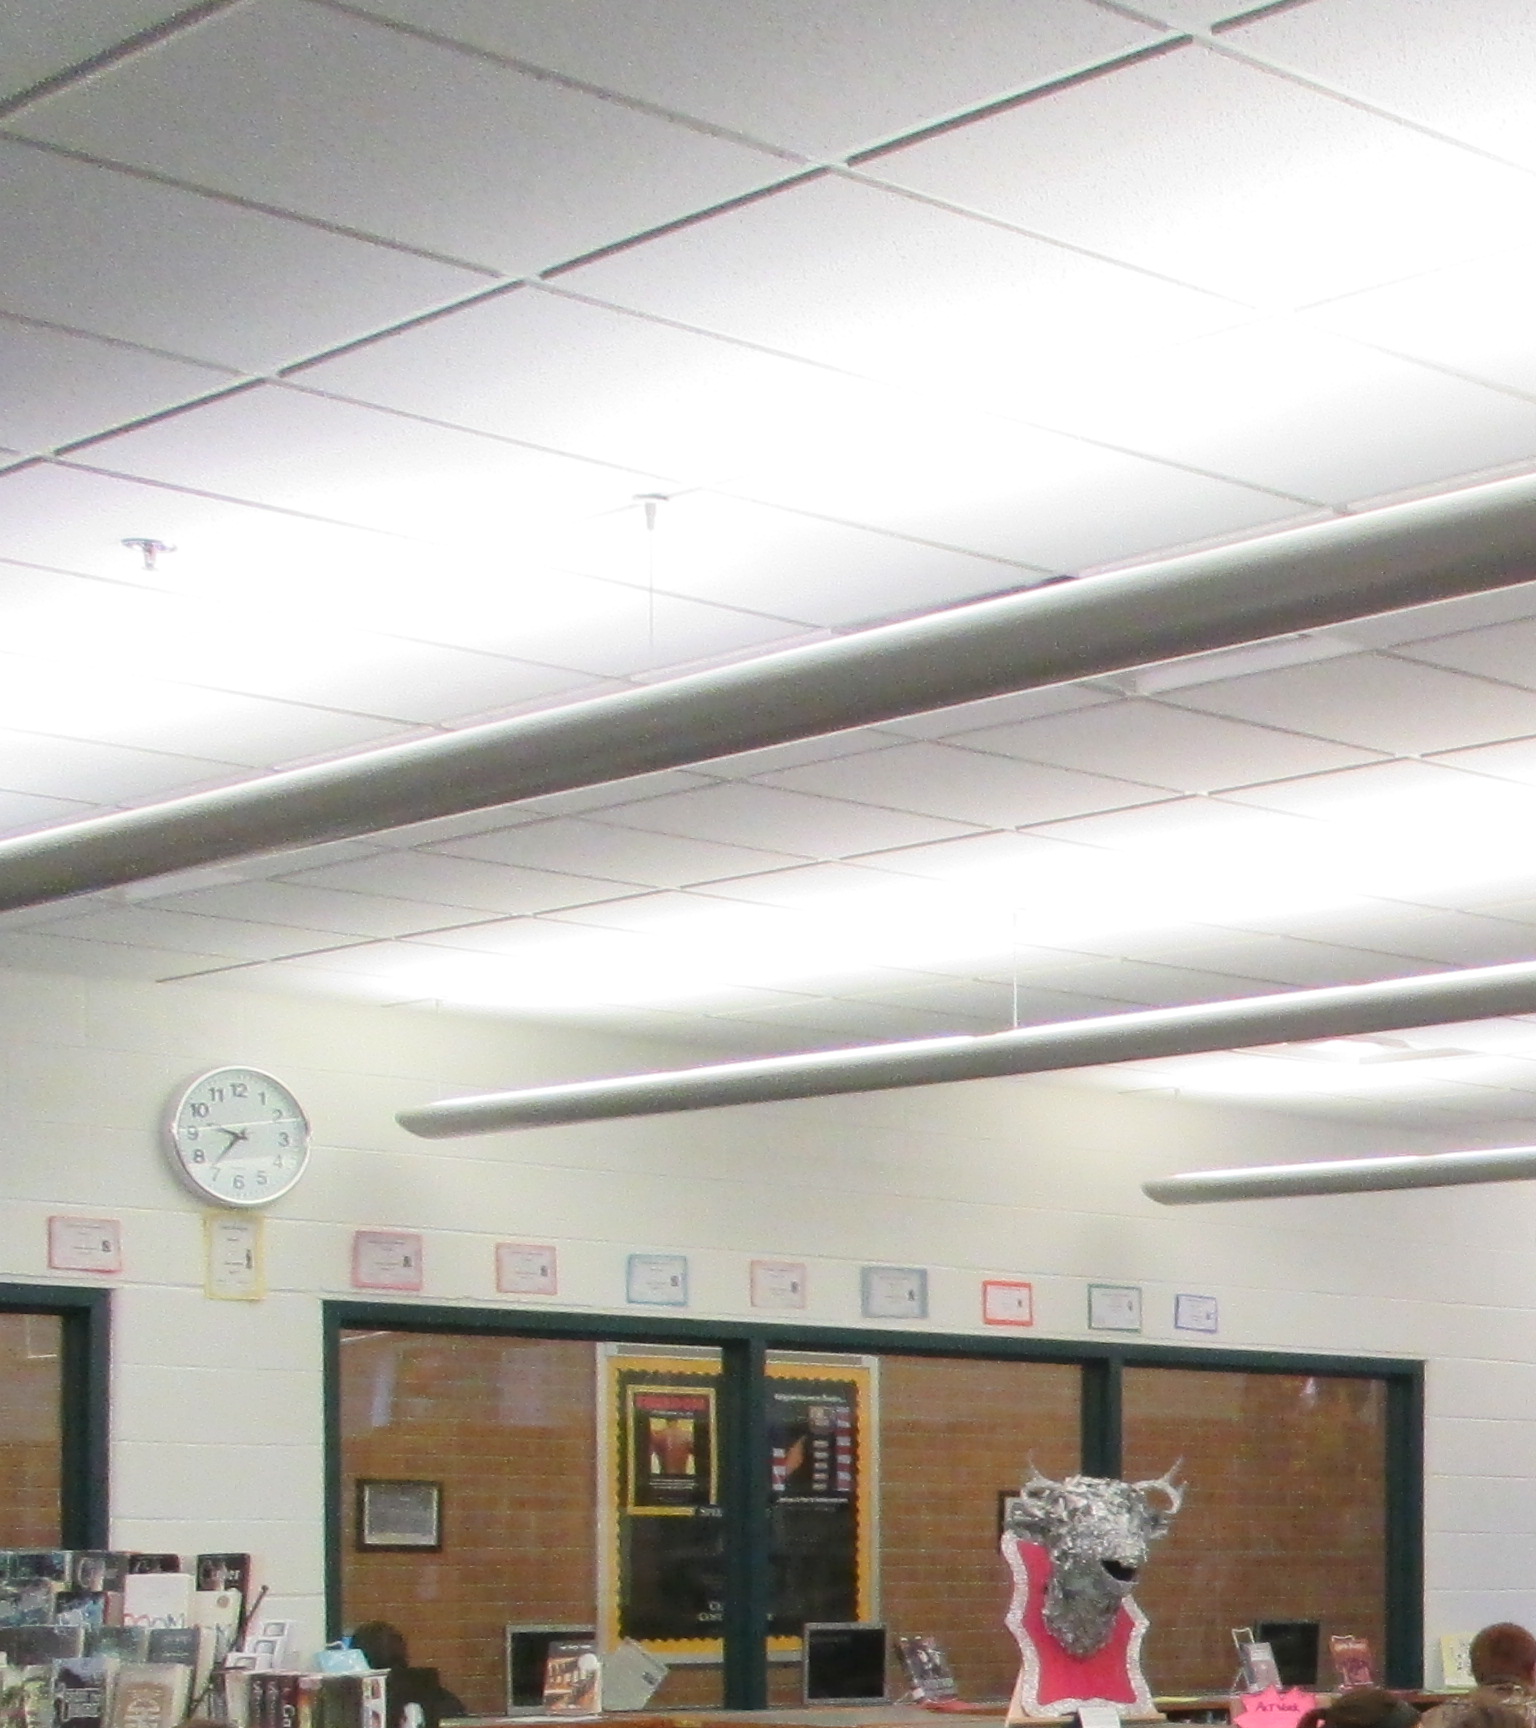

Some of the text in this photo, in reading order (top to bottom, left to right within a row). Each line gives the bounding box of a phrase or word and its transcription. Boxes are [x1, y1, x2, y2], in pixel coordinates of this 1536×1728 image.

[209, 1087, 224, 1102] 11
[230, 1083, 248, 1098] 12
[258, 1092, 266, 1105] 1
[190, 1103, 209, 1118] 10
[272, 1109, 283, 1122] 2
[187, 1126, 199, 1140] 9
[278, 1132, 289, 1147] 3
[193, 1149, 205, 1163] 8
[273, 1155, 283, 1168] 4
[211, 1167, 220, 1181] 7
[257, 1170, 267, 1185] 5
[233, 1175, 244, 1189] 6
